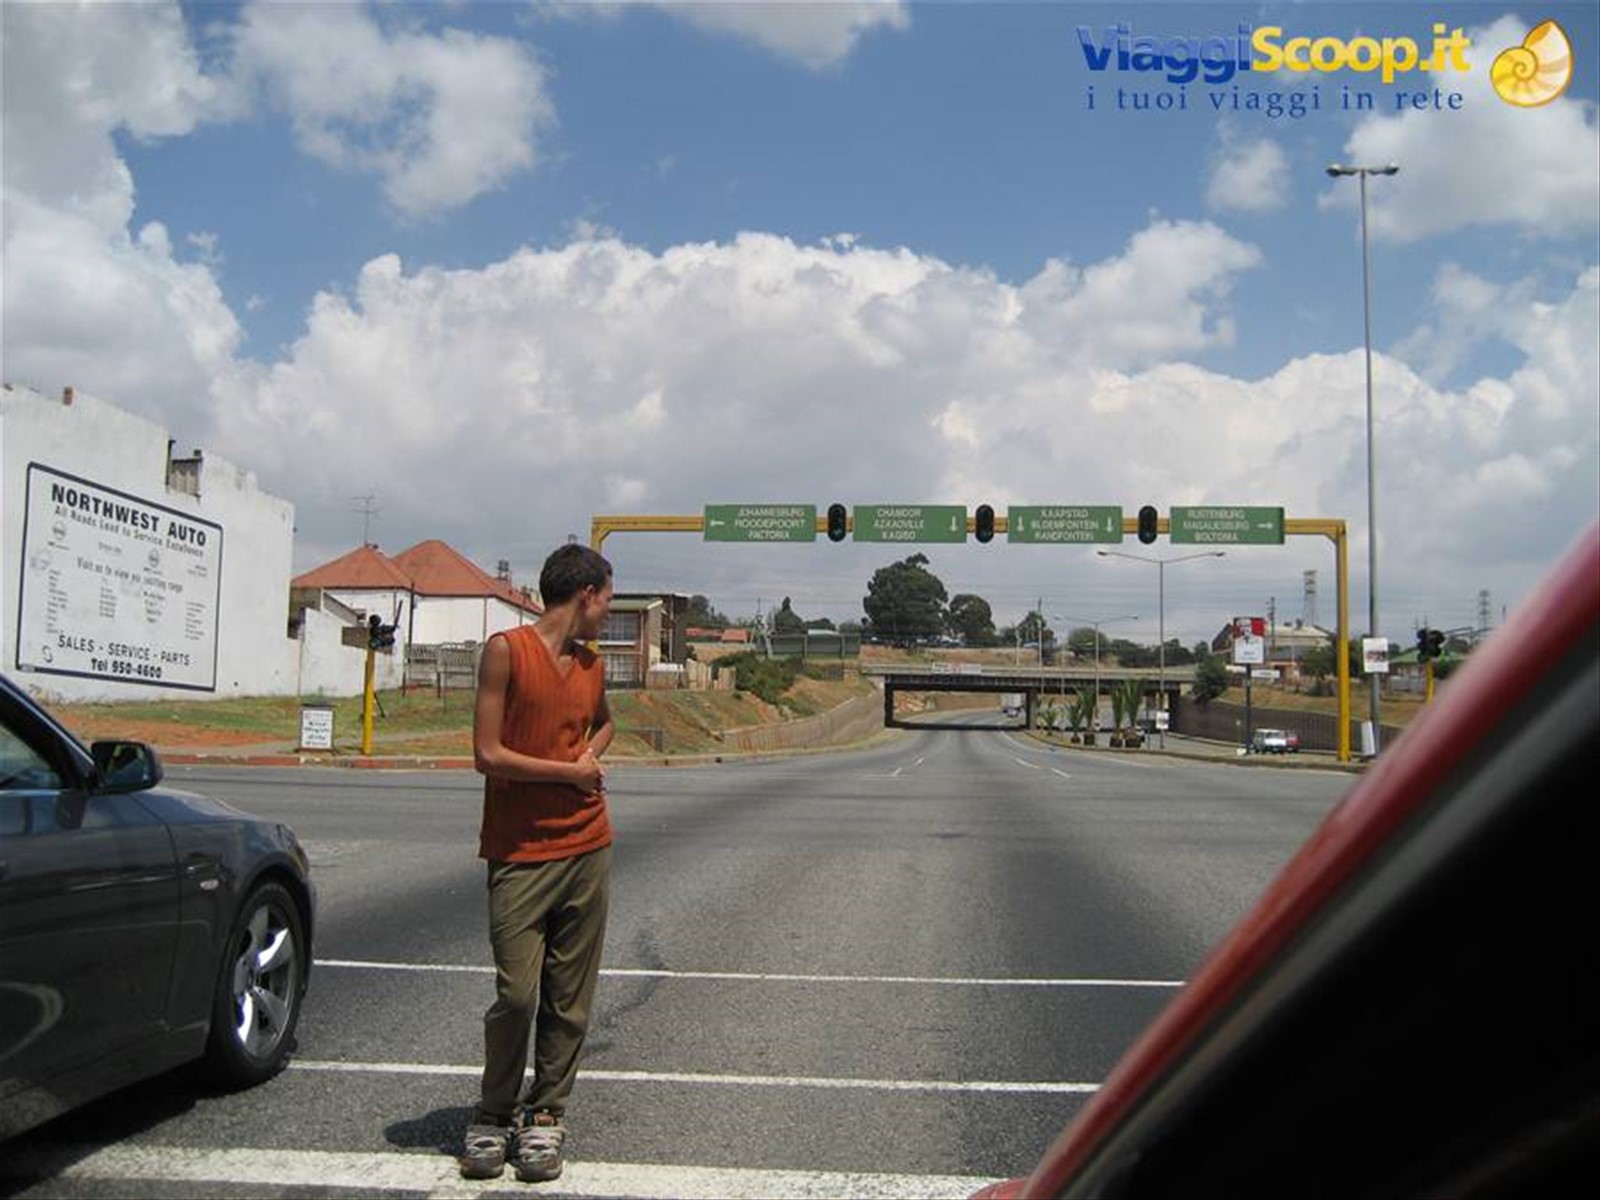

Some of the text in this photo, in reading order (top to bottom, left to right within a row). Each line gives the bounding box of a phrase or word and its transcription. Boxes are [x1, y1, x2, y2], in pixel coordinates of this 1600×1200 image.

[51, 483, 207, 547] NORTHWEST AUTO
[133, 528, 163, 546] Service
[58, 635, 95, 653] SALES
[108, 642, 151, 661] SERVICE
[160, 650, 190, 667] PARTS
[91, 657, 162, 679] Tel 950-4600
